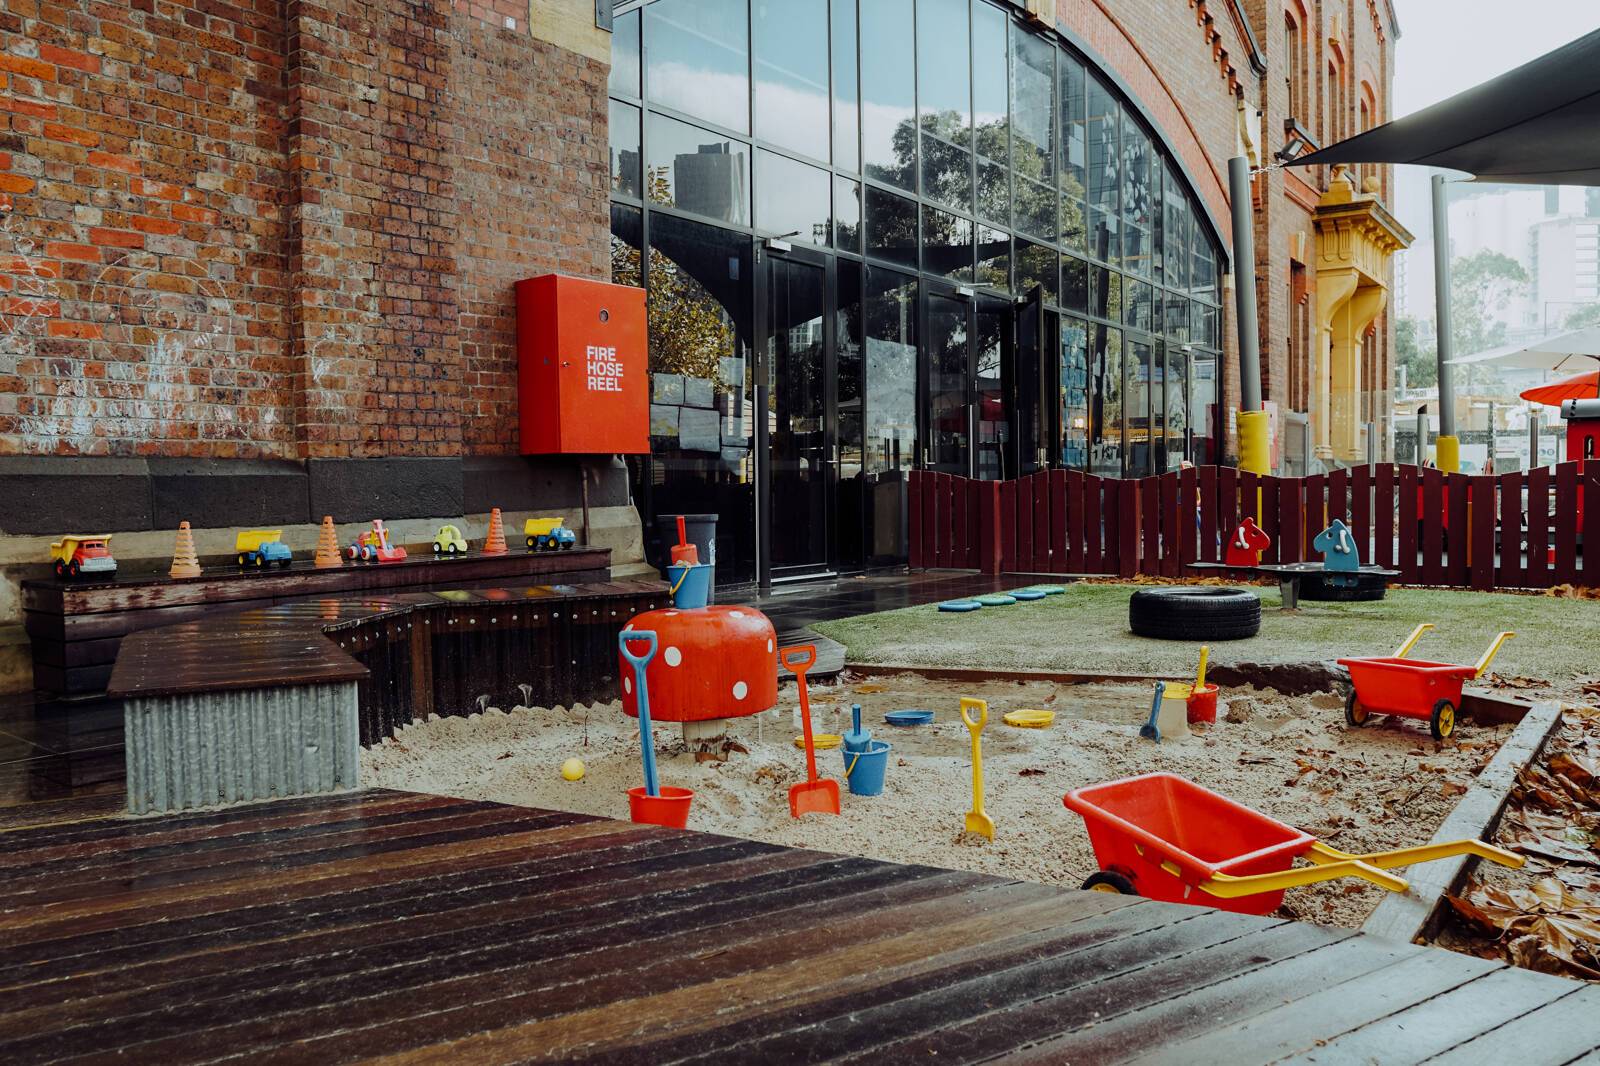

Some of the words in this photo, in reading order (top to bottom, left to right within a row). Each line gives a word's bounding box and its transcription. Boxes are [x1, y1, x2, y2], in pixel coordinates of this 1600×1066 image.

[587, 345, 616, 361] FIRE
[587, 361, 624, 377] HOSE
[588, 376, 622, 391] REEL
